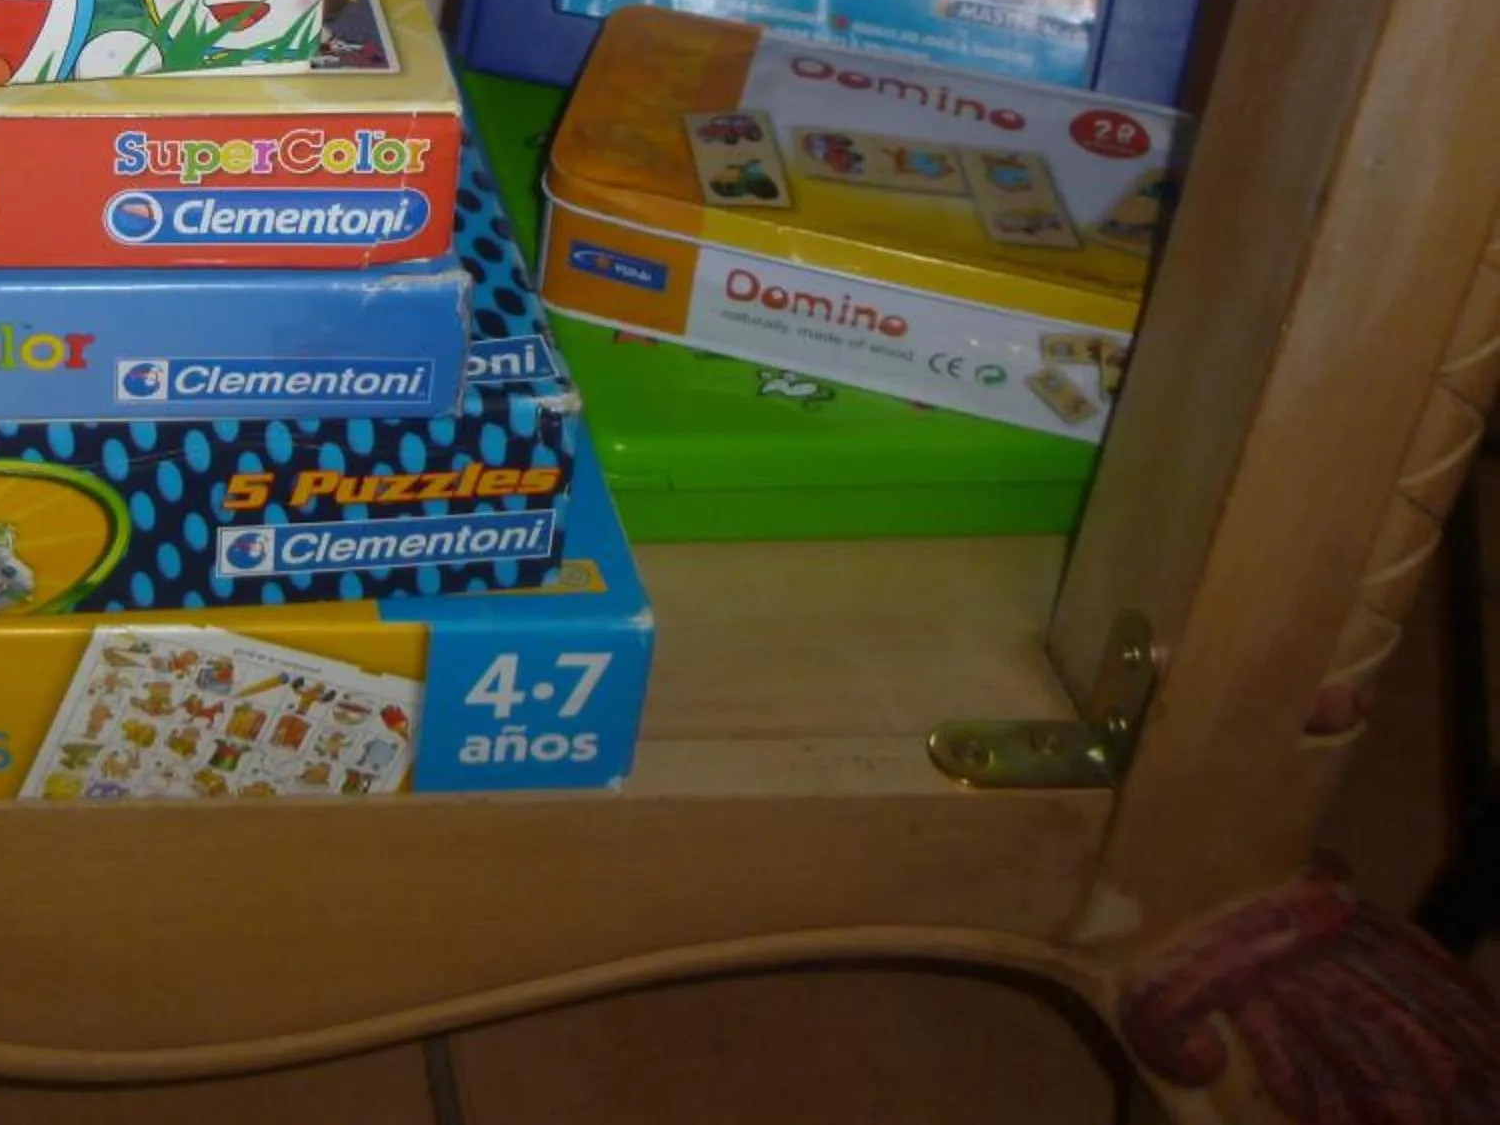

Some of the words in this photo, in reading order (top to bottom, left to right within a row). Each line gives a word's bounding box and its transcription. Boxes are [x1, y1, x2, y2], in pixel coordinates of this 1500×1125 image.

[790, 54, 1027, 132] Domino
[115, 129, 431, 184] SuperColor
[172, 197, 408, 236] Clementoni
[725, 268, 910, 338] Domino
[174, 364, 424, 396] Clementoni
[222, 471, 276, 510] 5
[288, 462, 561, 507] Puzzles
[280, 520, 544, 564] Clementoni
[458, 724, 599, 764] años
